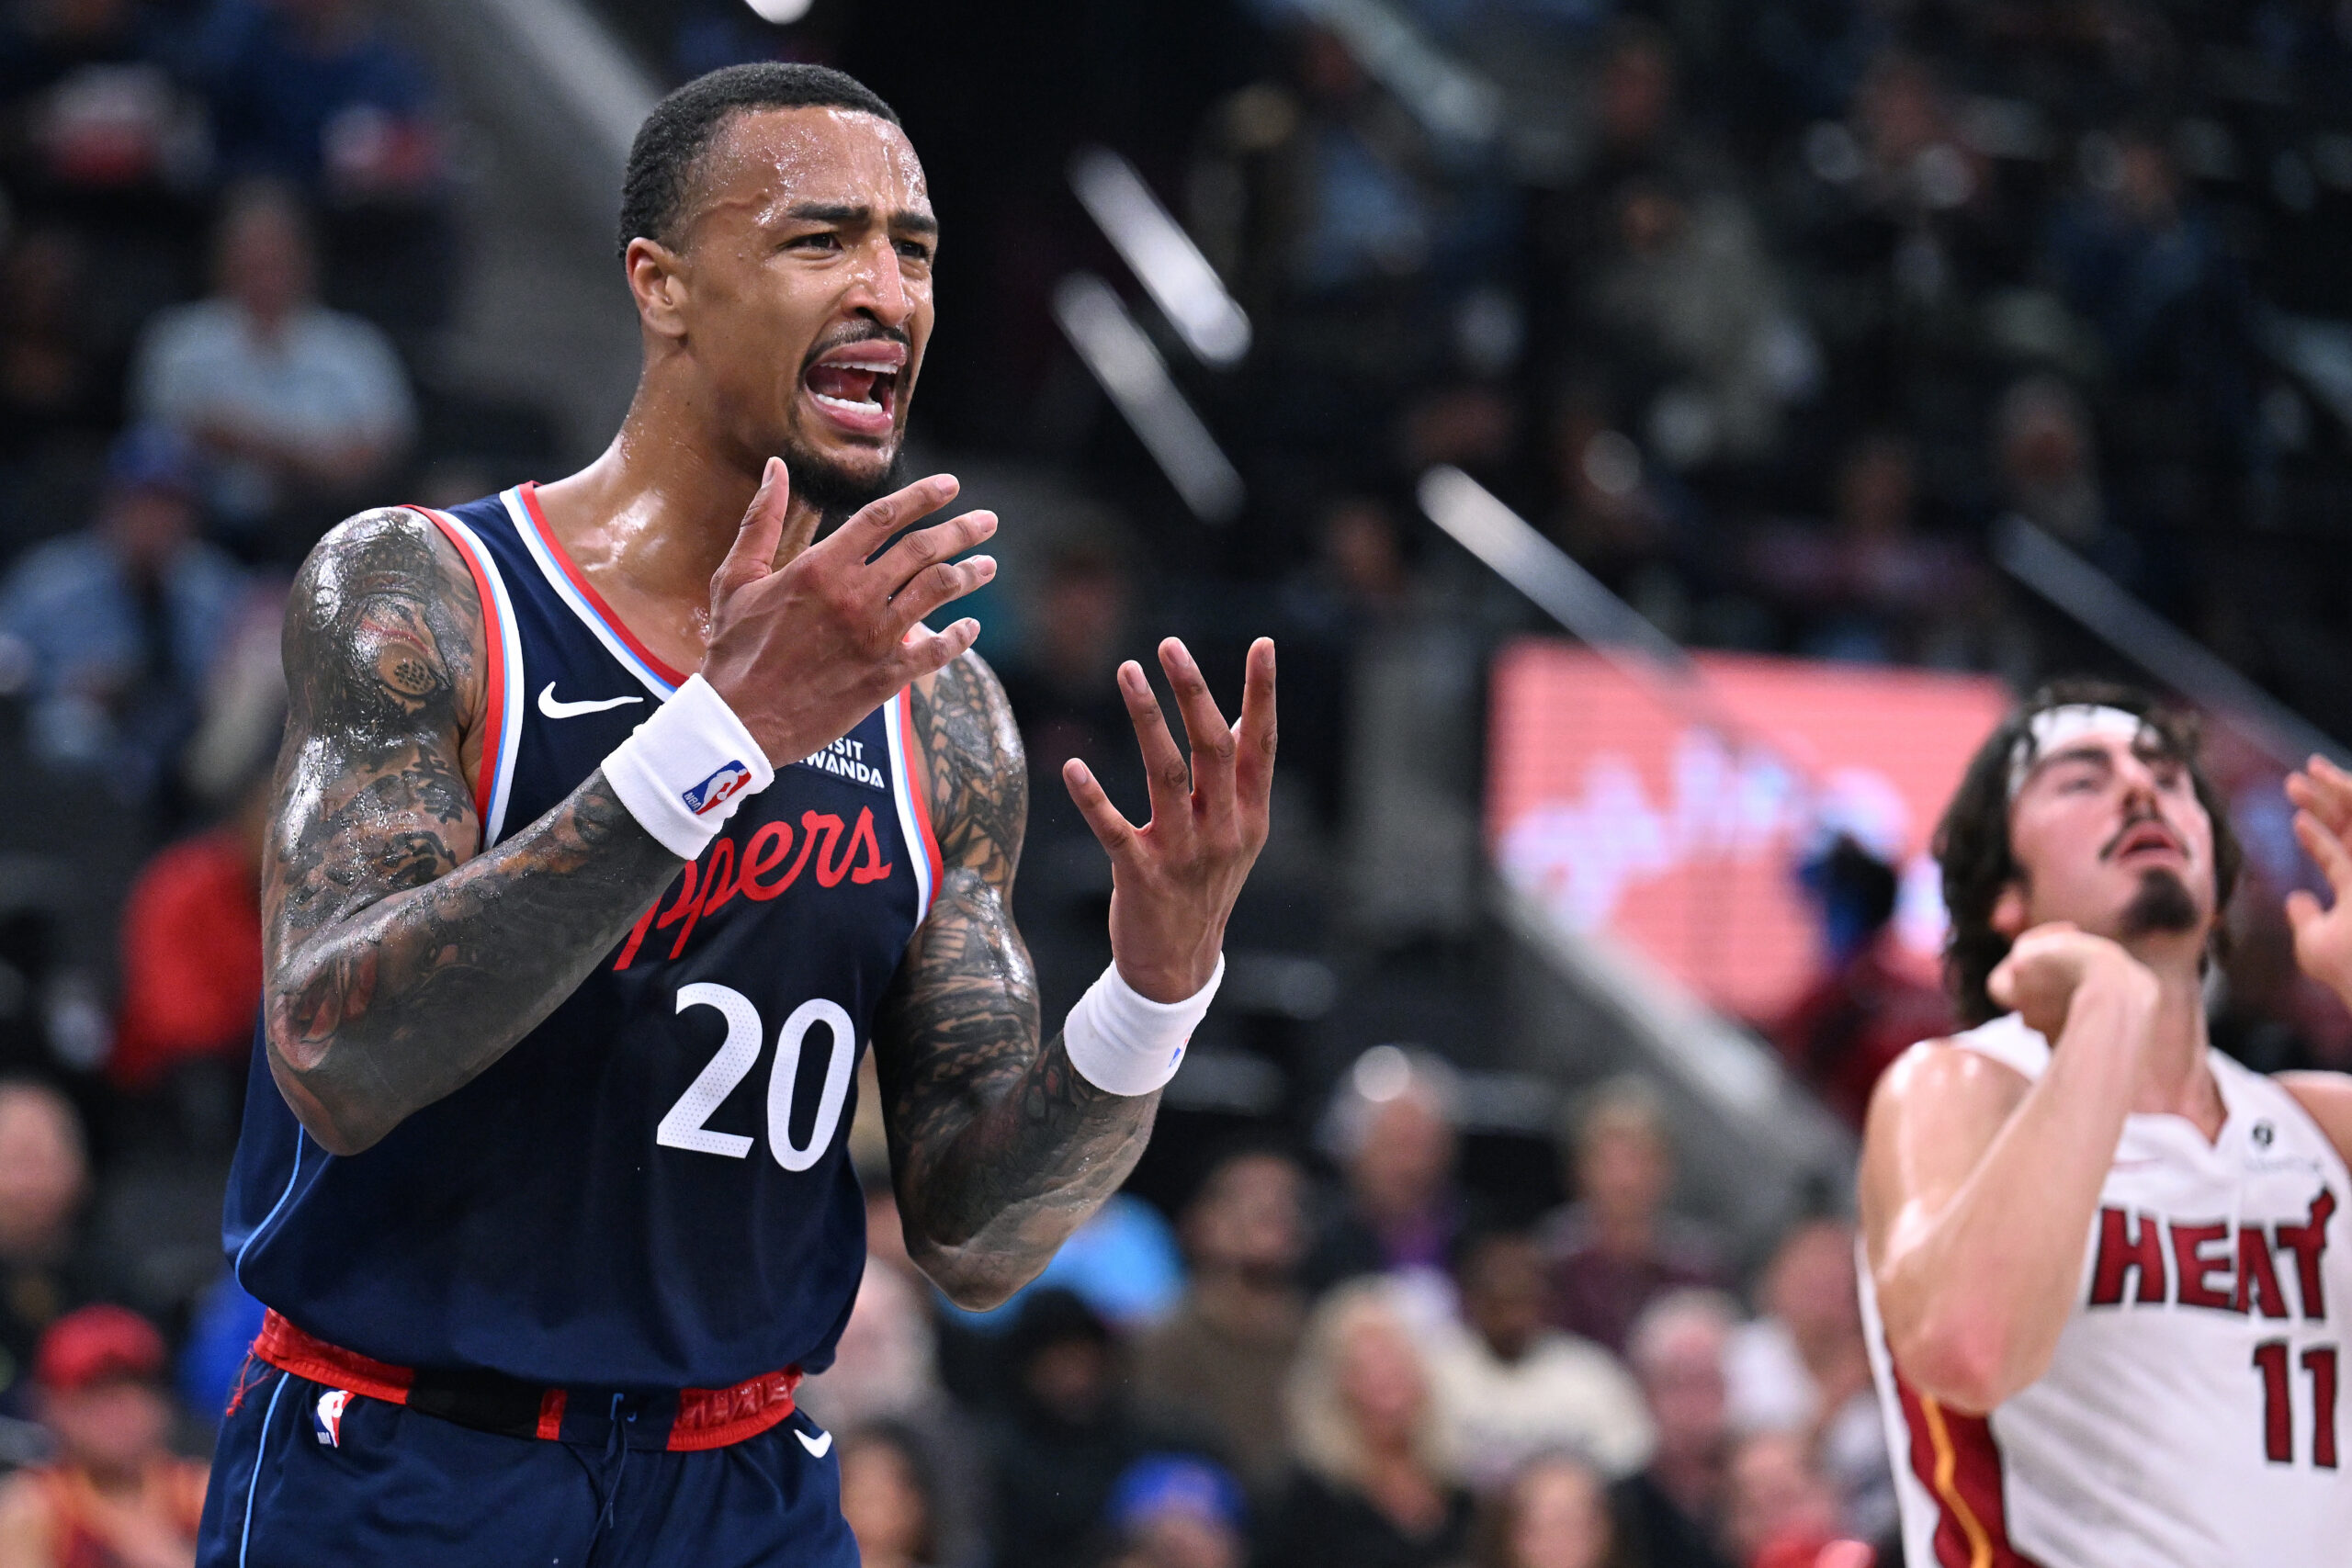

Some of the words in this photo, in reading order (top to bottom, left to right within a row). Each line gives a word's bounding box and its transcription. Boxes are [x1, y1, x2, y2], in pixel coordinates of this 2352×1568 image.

[684, 791, 701, 810] NBA
[798, 750, 885, 789] WANDA
[827, 738, 864, 761] SIT
[613, 806, 891, 971] ppers
[656, 982, 856, 1172] 20
[2087, 1187, 2336, 1322] HEAT
[2252, 1337, 2338, 1470] 11
